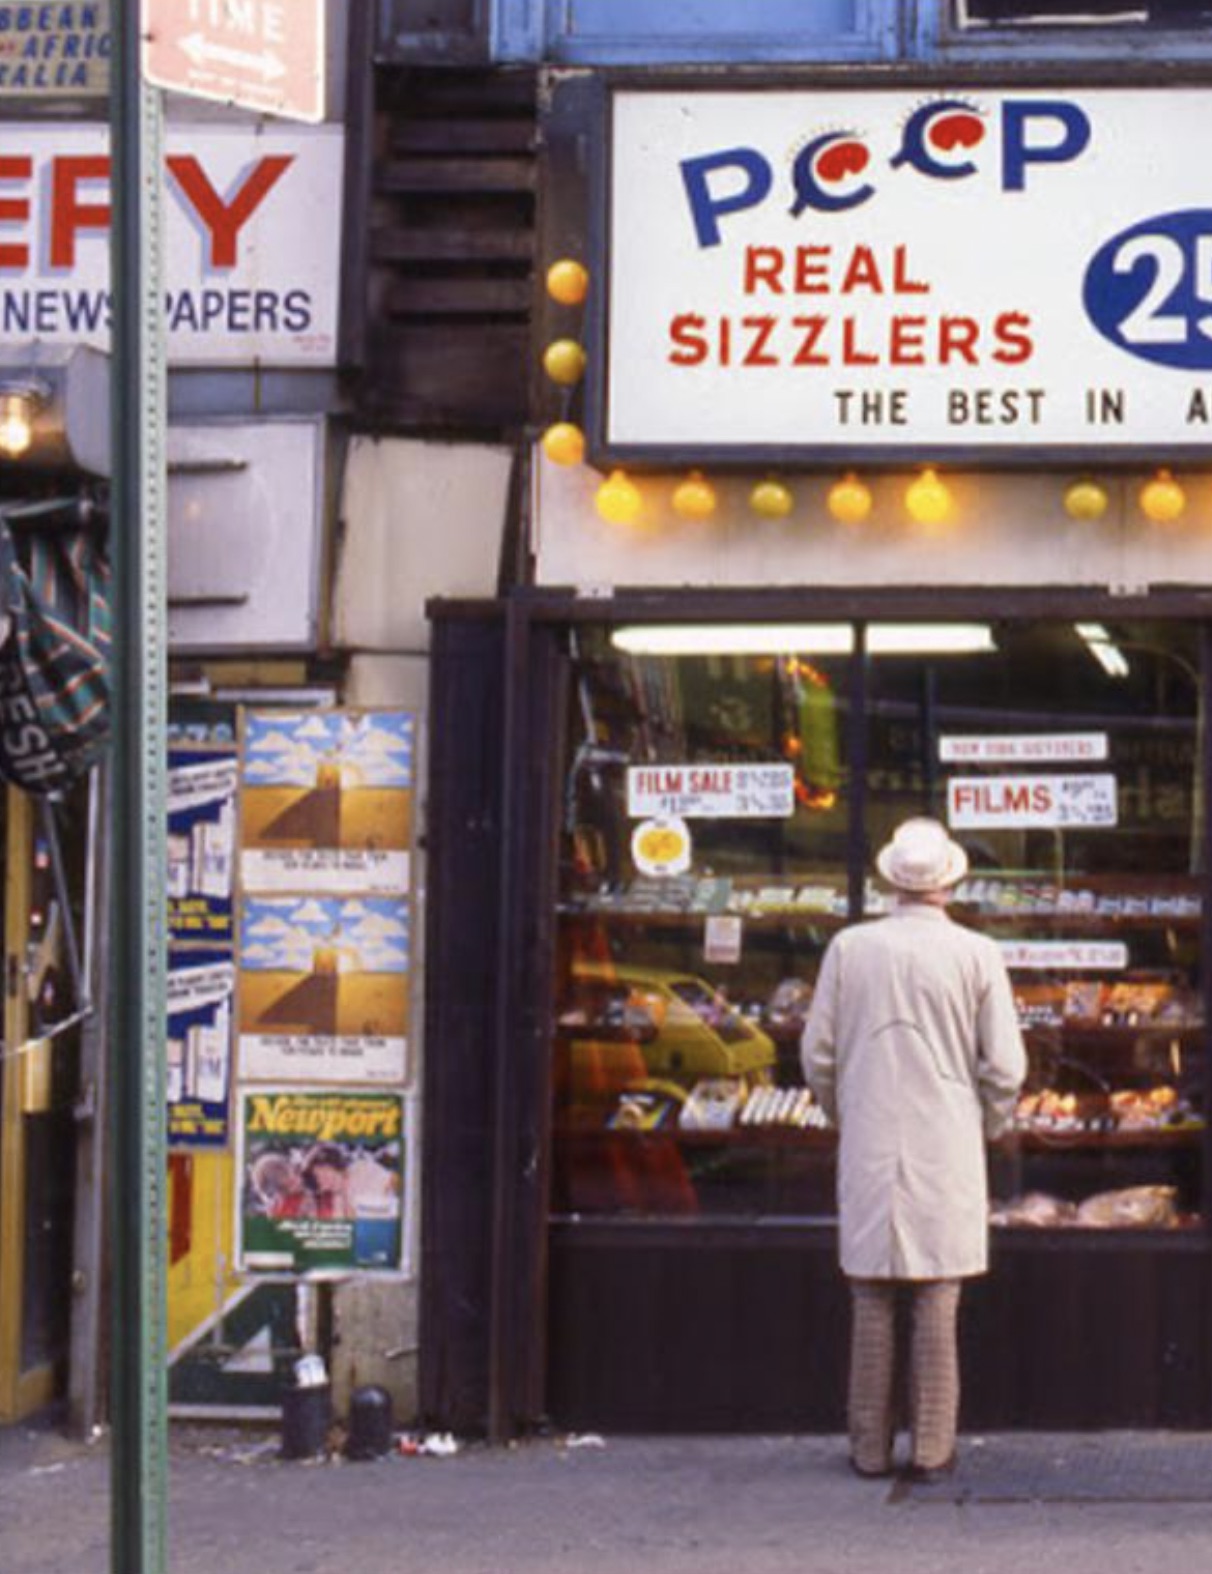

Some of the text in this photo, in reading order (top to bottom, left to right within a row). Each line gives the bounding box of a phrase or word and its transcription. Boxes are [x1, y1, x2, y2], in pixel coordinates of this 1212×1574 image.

[743, 244, 930, 294] REAL
[667, 311, 1033, 366] SIZZLERS
[834, 389, 908, 425] THE
[947, 389, 1045, 425] BEST
[1086, 389, 1125, 425] IN
[635, 771, 682, 794] FILM
[689, 770, 732, 794] SALE
[953, 783, 1053, 814] FILMS
[248, 1094, 401, 1141] Newport
